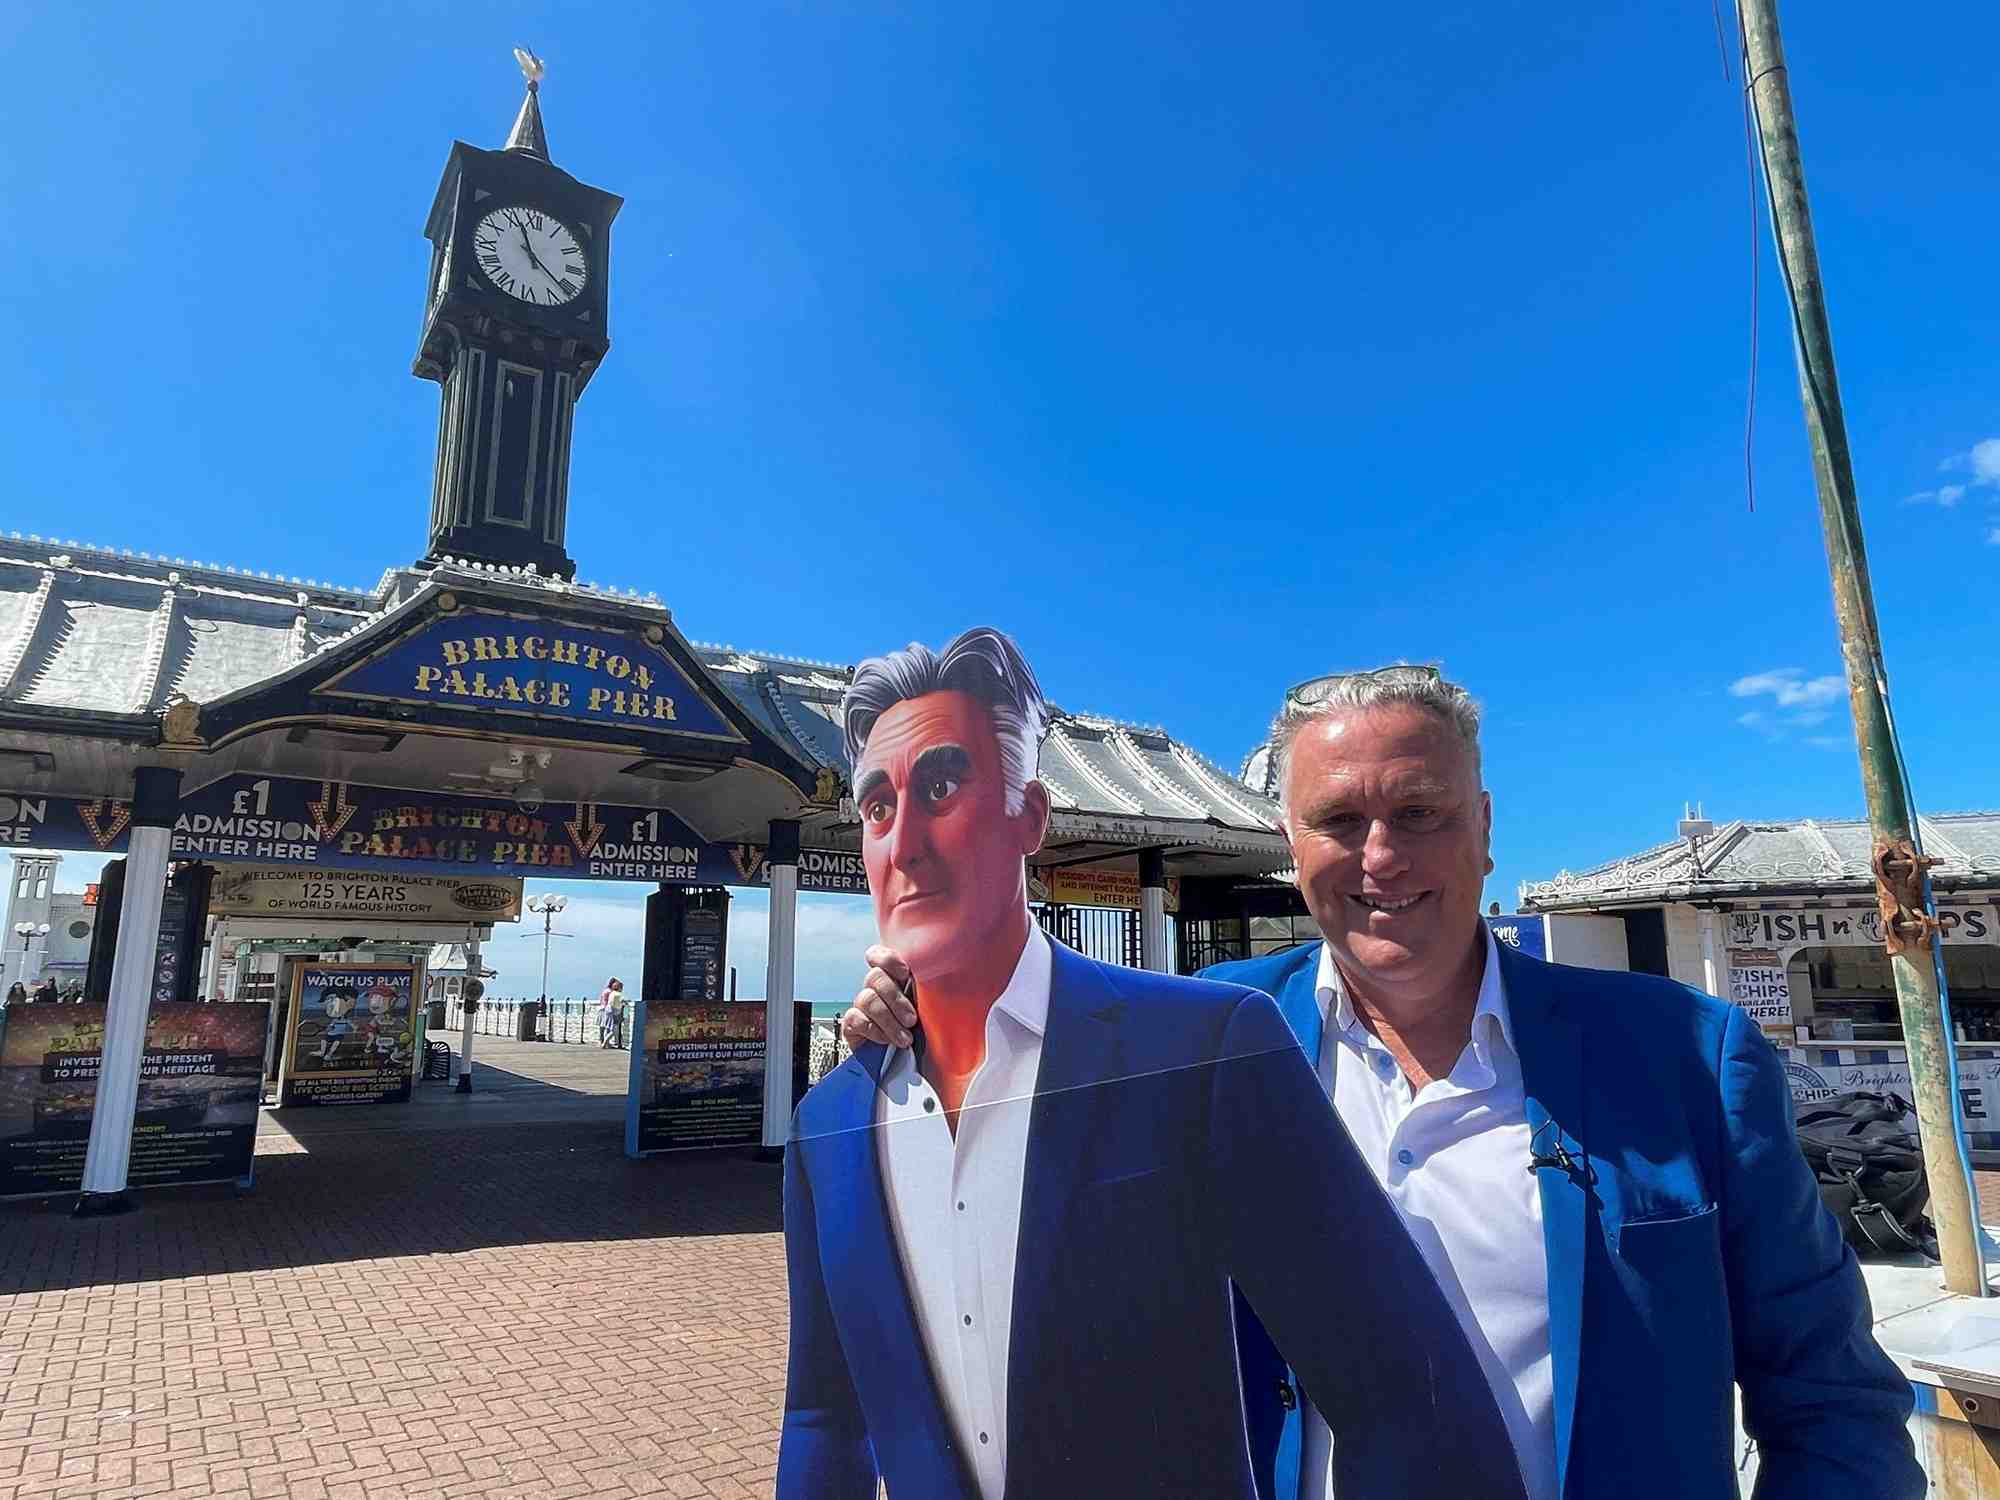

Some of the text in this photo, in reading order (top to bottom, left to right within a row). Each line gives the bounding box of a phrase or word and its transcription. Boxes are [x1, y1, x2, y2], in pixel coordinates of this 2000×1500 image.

[442, 636, 655, 690] BRIGHTON
[414, 665, 677, 721] PALACE PIER
[232, 779, 270, 816] £1
[174, 813, 321, 842] ADMISSION
[631, 811, 659, 842] £1
[171, 835, 318, 861] ENTER HERE
[338, 831, 576, 866] PALACE PIER
[590, 842, 699, 863] ADMISSION
[590, 861, 697, 879] ENTER HERE
[798, 853, 866, 876] ADMISS
[240, 870, 461, 889] WELCOME TO BRIGHTON PALACE PIER
[801, 873, 852, 888] ENTER
[302, 883, 407, 902] 125 YEARS
[1094, 893, 1141, 905] ENTER HE
[268, 899, 433, 914] OF WORLD FAMOUS HISTORY
[307, 975, 411, 987] WATCH US PLAY!
[1749, 1006, 1791, 1018] HERE!
[59, 1054, 214, 1068] INVEST THE PRESENT
[715, 1050, 732, 1058] OUR
[733, 1050, 765, 1058] HERITAG
[54, 1064, 216, 1079] TO PRES UR HERITAGE
